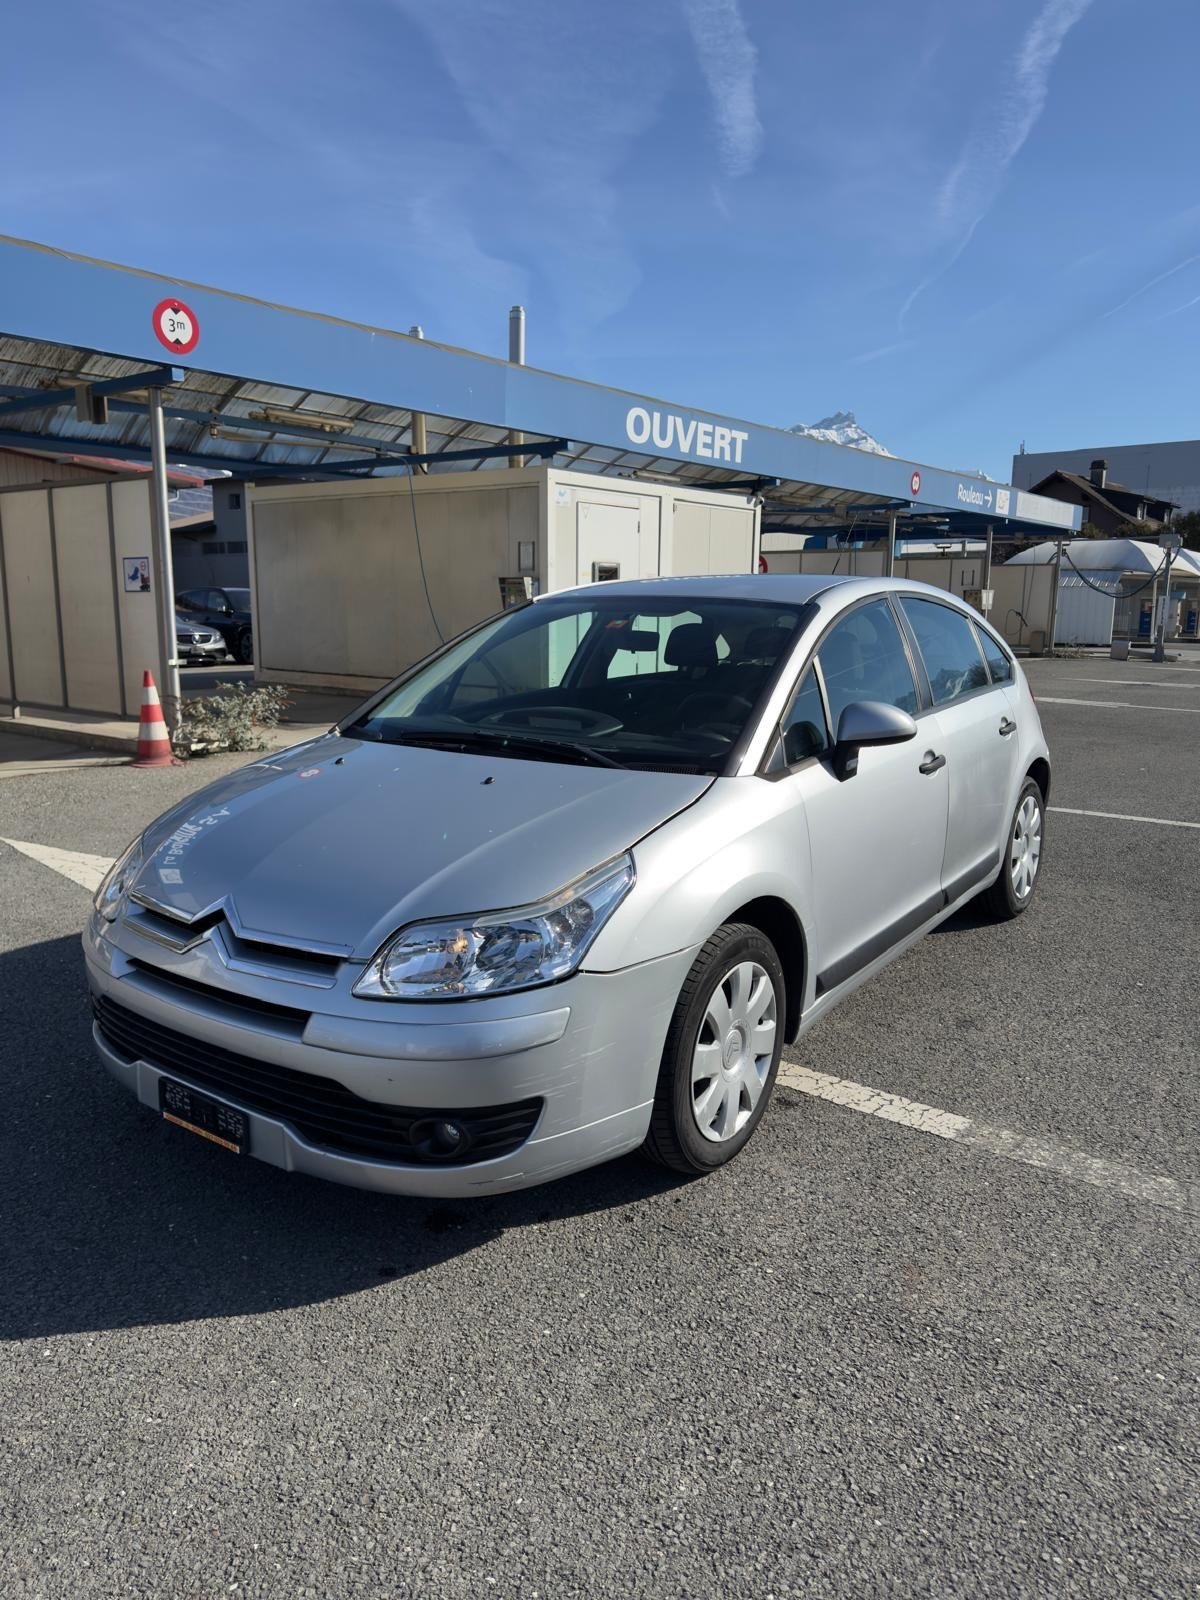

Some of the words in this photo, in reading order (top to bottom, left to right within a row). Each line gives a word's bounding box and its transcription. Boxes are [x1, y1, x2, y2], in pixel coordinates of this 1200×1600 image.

[168, 318, 186, 333] 3m
[626, 407, 749, 464] OUVERT
[957, 483, 984, 505] Rouleau
